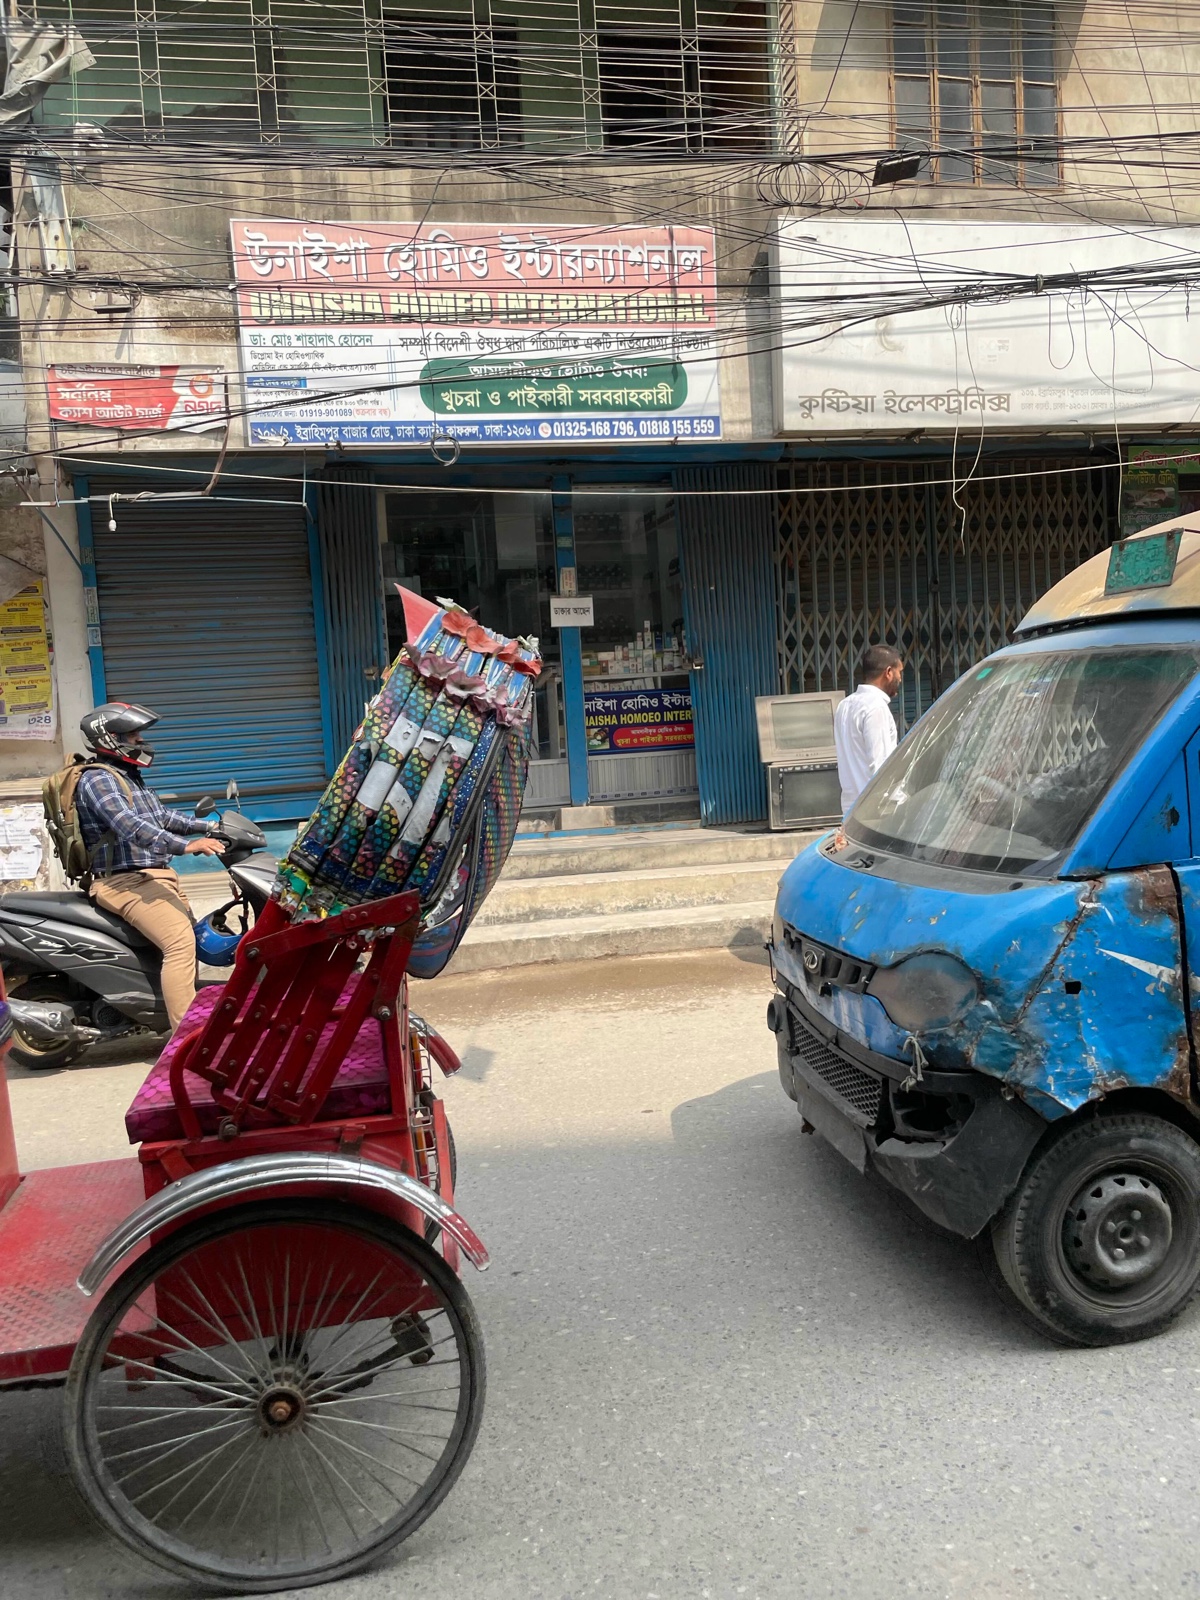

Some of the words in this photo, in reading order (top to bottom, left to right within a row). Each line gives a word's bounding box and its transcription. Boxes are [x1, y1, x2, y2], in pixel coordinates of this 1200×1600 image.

[240, 226, 371, 283] উনাইশা
[384, 228, 489, 286] হোমিও
[498, 230, 708, 285] ইন্টারন্যাশনাল
[251, 292, 385, 324] UNAISHA
[390, 293, 493, 324] HOMEO
[497, 293, 711, 324] INTERNATIONAL
[271, 334, 292, 348] মোঃ
[295, 333, 335, 348] শাহাদাৎ
[338, 333, 373, 347] হোসেন
[435, 332, 471, 351] বিদেশী
[477, 332, 501, 351] ঔষধ
[505, 335, 526, 351] দ্বারা
[531, 331, 580, 351] পরিচালিত
[584, 332, 612, 351] একটি
[274, 350, 284, 360] ইন
[441, 389, 481, 411] খুচরা
[487, 391, 501, 406] ও
[508, 384, 574, 409] পাইকারী
[577, 383, 674, 408] সরবরাহকারী
[798, 388, 876, 420] কুষ্টিয়া
[883, 386, 1012, 415] ইলেকট্রনিক্স
[58, 406, 93, 418] ক্যাশ
[95, 404, 133, 418] আউট
[299, 408, 352, 418] 01919-901089
[295, 423, 339, 442] ইব্রাহিমপুর
[343, 425, 367, 439] বাজার
[371, 425, 393, 440] রোড,
[397, 424, 415, 438] ঢাকা
[553, 421, 610, 437] 01325-168
[613, 421, 637, 438] 796,
[639, 420, 670, 436] 01818
[672, 420, 691, 435] 155
[693, 420, 714, 434] 559
[553, 607, 571, 616] ডাক্তার
[584, 697, 617, 712] নাইশা
[622, 695, 659, 711] হোমিও
[620, 711, 661, 725] HOMOEO
[664, 709, 693, 721] INTER
[640, 734, 663, 744] পাইকারী
